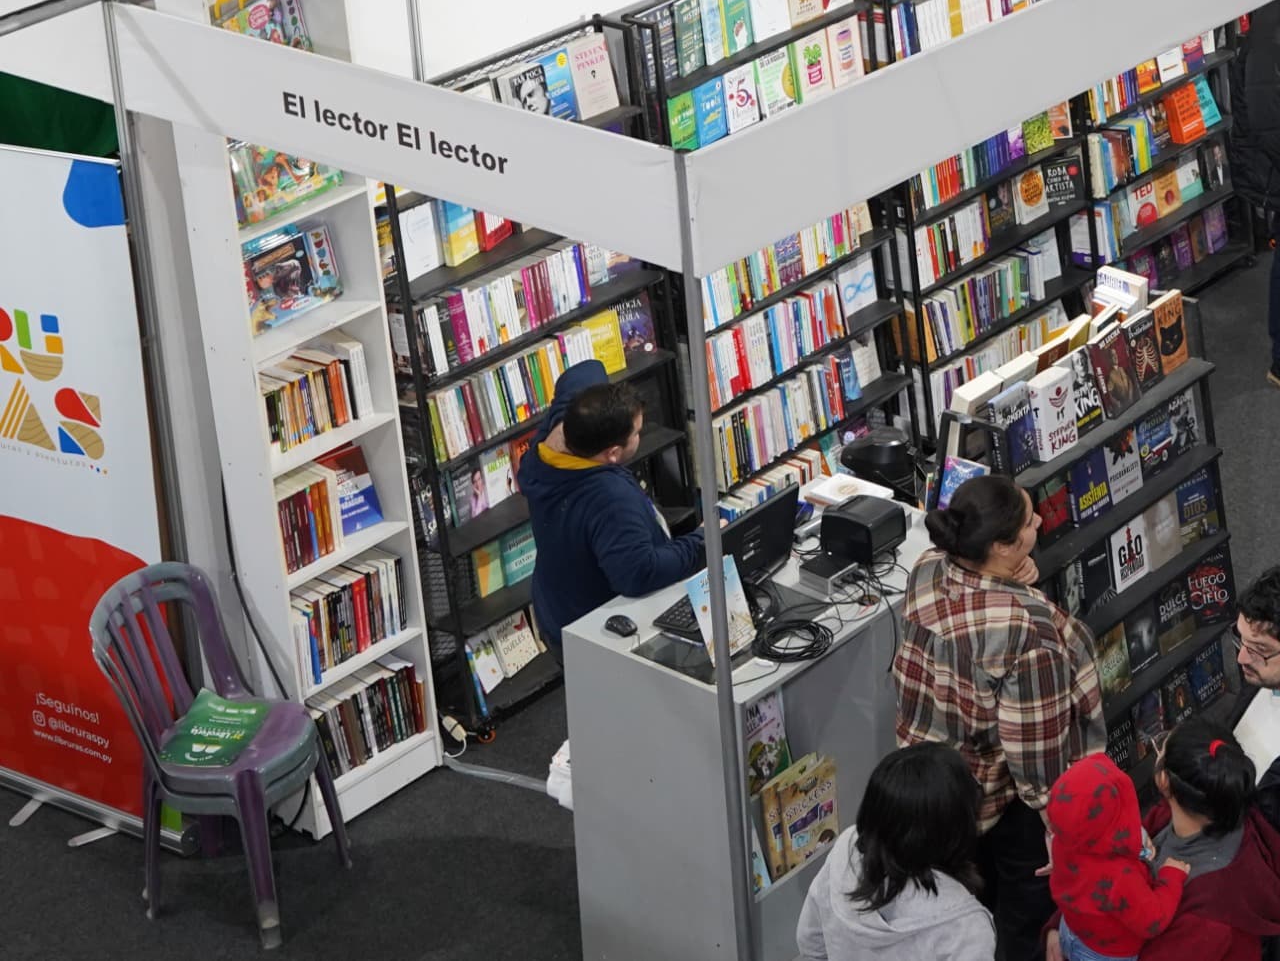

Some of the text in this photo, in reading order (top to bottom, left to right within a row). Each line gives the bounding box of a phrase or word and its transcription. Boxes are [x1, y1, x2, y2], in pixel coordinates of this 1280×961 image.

[574, 41, 605, 61] STEVEN
[576, 54, 606, 71] PINKER
[282, 91, 508, 175] El lector El lector
[1047, 165, 1067, 177] ROBA
[1045, 180, 1075, 193] ARTISTA
[1132, 181, 1153, 201] TED
[1075, 387, 1100, 417] KING
[1056, 407, 1065, 421] IT
[1048, 419, 1075, 441] STEPHEN
[1051, 431, 1077, 455] KING
[1079, 482, 1108, 511] ASISTENTA
[1183, 498, 1208, 520] DIOS
[1187, 572, 1226, 592] FUEGO
[1159, 591, 1187, 616] DULCE
[1190, 589, 1230, 610] CIELO
[35, 692, 101, 725] ¡Seguinos!
[48, 717, 110, 749] @libruraspy
[33, 729, 113, 764] www.libruras.com.py
